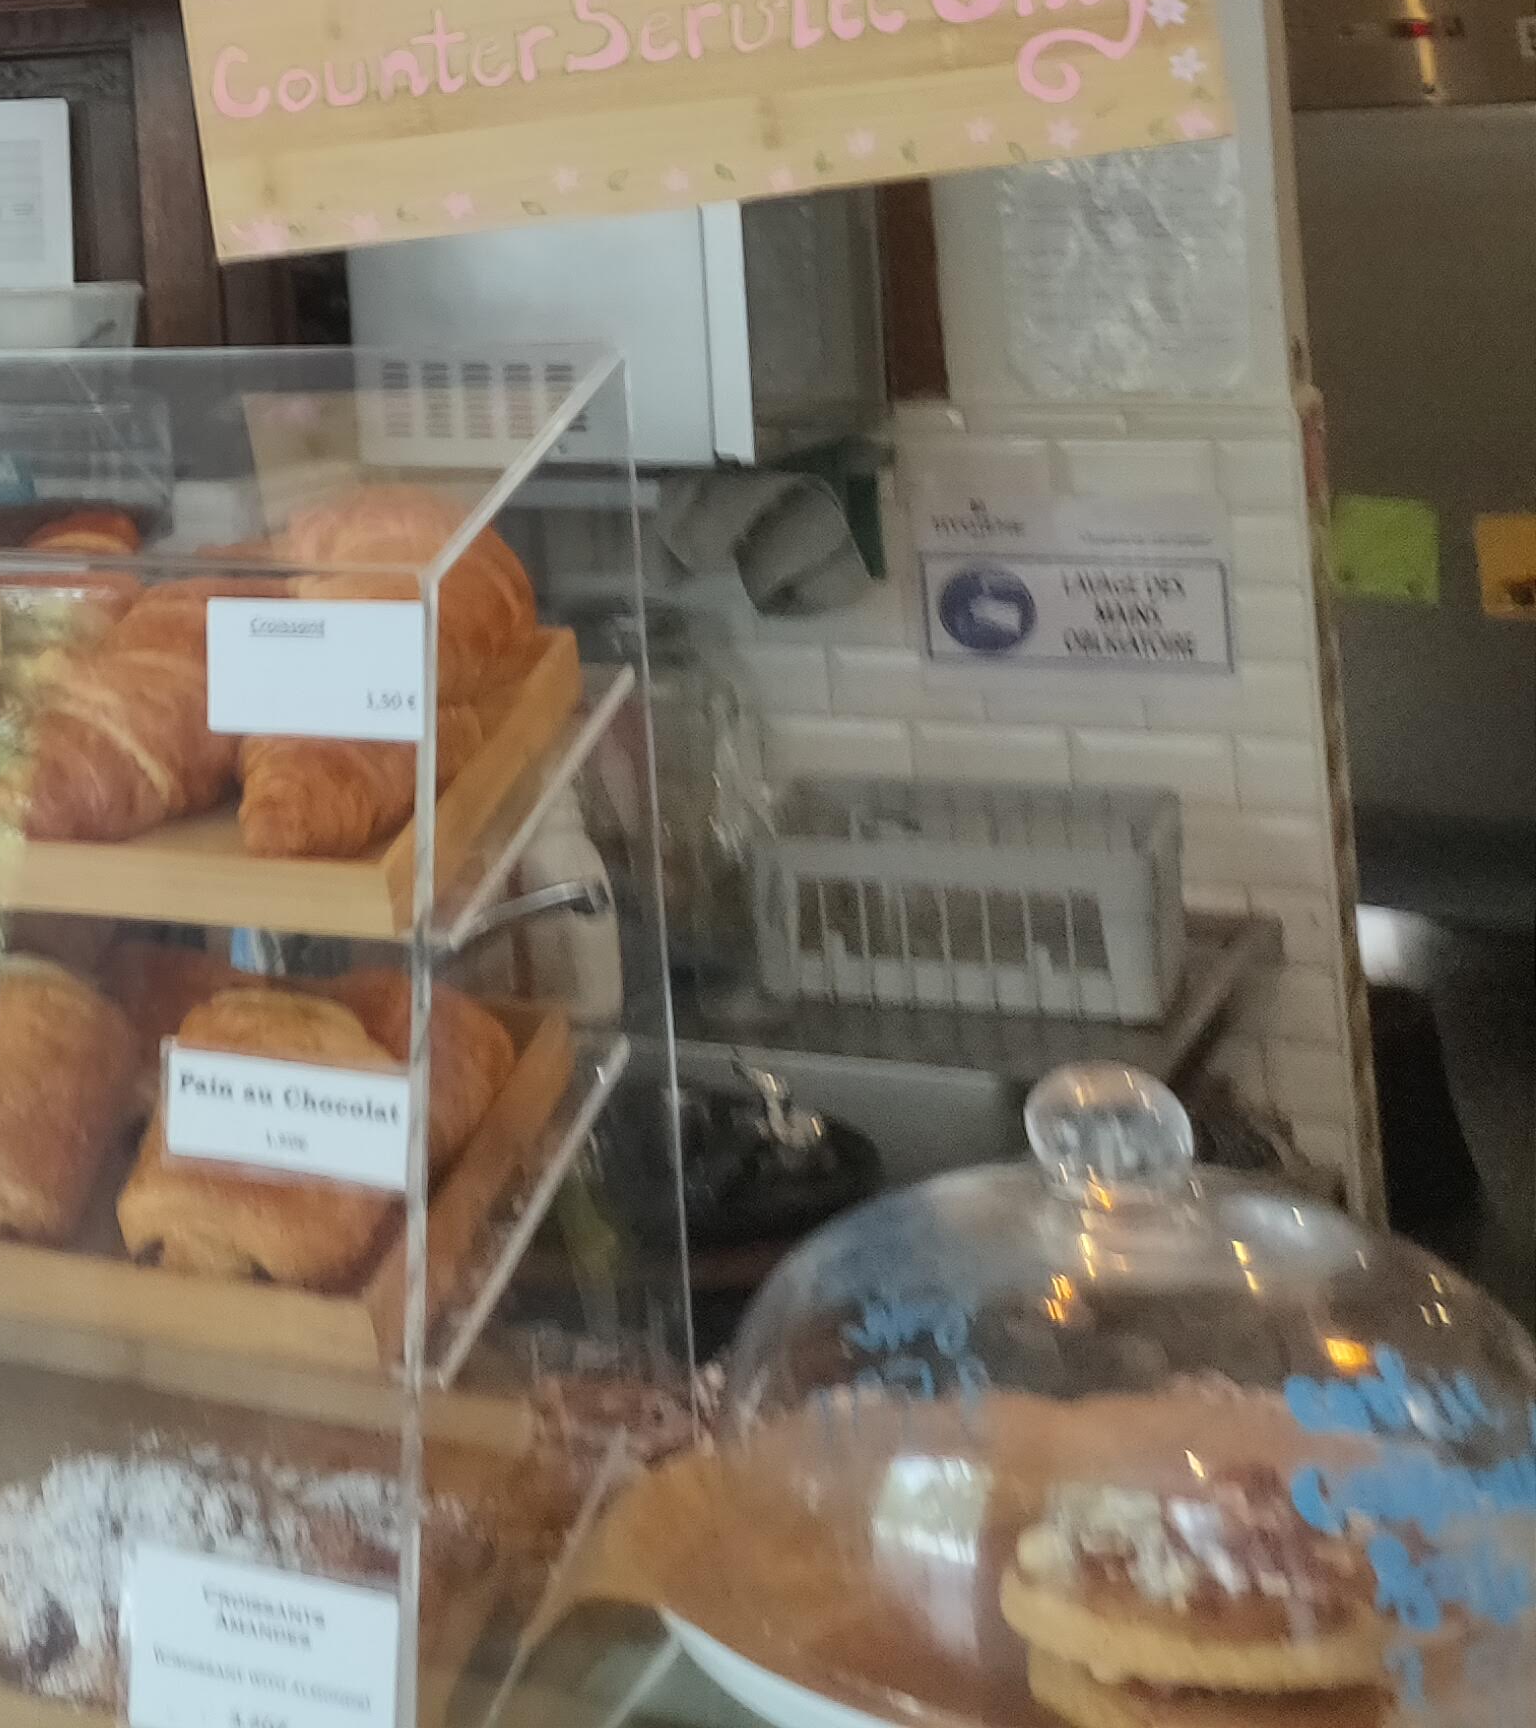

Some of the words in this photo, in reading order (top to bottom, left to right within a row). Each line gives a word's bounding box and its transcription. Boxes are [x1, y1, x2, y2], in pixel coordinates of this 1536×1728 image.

[211, 7, 560, 120] Counter
[179, 1073, 234, 1101] Pain
[243, 1085, 273, 1106] au
[283, 1085, 401, 1125] Chocolat
